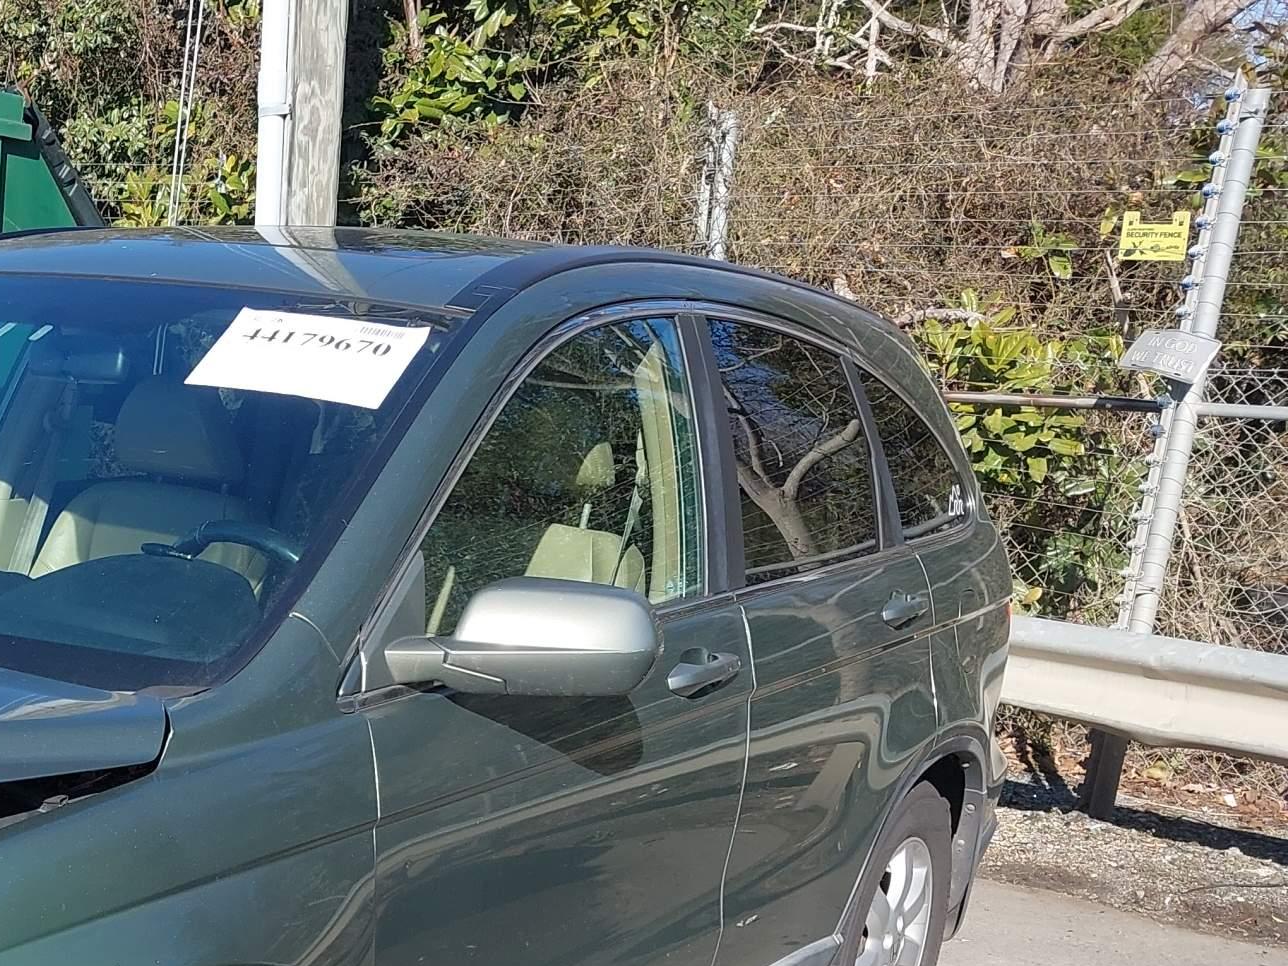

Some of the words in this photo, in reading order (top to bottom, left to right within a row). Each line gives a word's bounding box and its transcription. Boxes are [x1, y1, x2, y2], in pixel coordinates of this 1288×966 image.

[1126, 231, 1160, 239] SECURITY
[1160, 231, 1183, 239] FENCE
[243, 327, 392, 357] 44179670
[1148, 336, 1162, 347] IN
[1164, 337, 1198, 354] GOD
[1131, 350, 1149, 362] WE
[1152, 351, 1194, 373] TRUST
